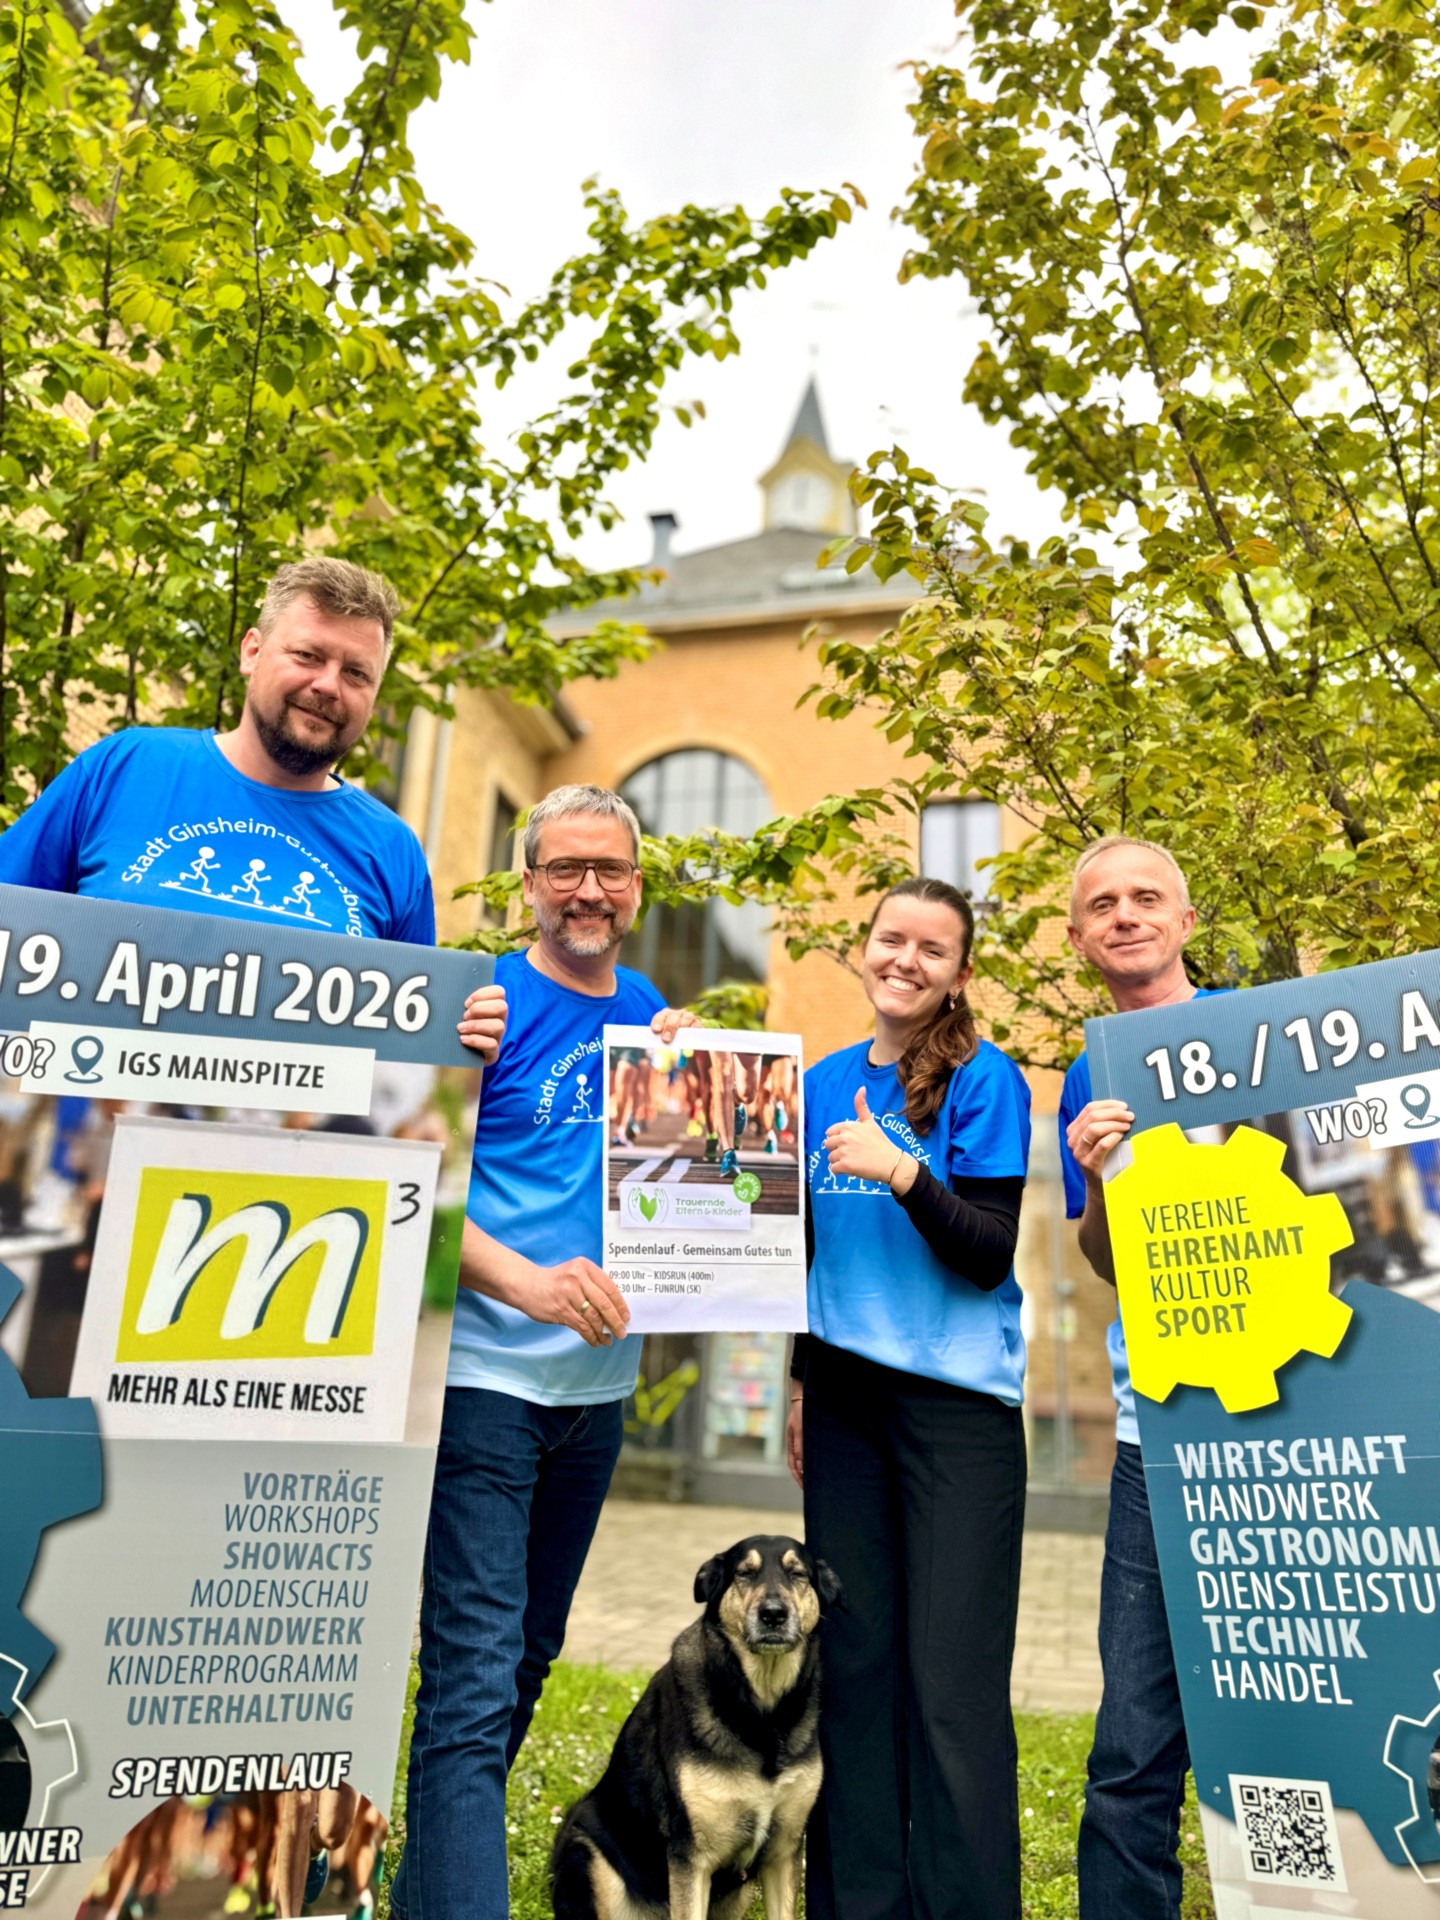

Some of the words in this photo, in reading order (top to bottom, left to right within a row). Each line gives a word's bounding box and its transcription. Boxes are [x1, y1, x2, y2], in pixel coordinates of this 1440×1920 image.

[121, 836, 172, 884] Stadt
[95, 941, 262, 1025] April
[273, 961, 430, 1033] 2026
[0, 1034, 56, 1079] O?
[1145, 1040, 1238, 1101] 18.
[1284, 1009, 1387, 1073] 19.
[1401, 990, 1440, 1053] A
[118, 1050, 162, 1077] IGS
[167, 1054, 325, 1089] MAINSPITZE
[533, 1078, 560, 1125] Stadt
[551, 1036, 604, 1077] Ginshei
[1306, 1097, 1388, 1145] WO?
[675, 1198, 726, 1207] Trauernde
[1141, 1195, 1251, 1234] VEREINE
[608, 1242, 676, 1257] Spendenlauf
[683, 1243, 742, 1257] Gemeinsam
[744, 1244, 773, 1257] Gutes
[774, 1246, 792, 1257] tun
[1145, 1225, 1304, 1270] EHRENAMT
[609, 1270, 631, 1280] 09:00
[631, 1270, 645, 1280] Uhr
[654, 1271, 687, 1280] KIDSRUN
[688, 1271, 714, 1282] (400m)
[632, 1284, 646, 1293] Uhr
[654, 1284, 685, 1293] FUNRUN
[686, 1284, 702, 1295] (5K)
[1150, 1266, 1252, 1303] KULTUR
[1155, 1302, 1247, 1338] SPORT
[107, 1373, 178, 1405] MEHR
[183, 1378, 229, 1407] ALS
[233, 1380, 286, 1410] EINE
[290, 1383, 367, 1413] MESSE
[1173, 1435, 1407, 1479] WIRTSCHAFT
[243, 1468, 384, 1503] VORTRÄGE
[1182, 1481, 1380, 1522] HANDWERK
[224, 1503, 380, 1535] WORKSHOPS
[223, 1541, 373, 1571] SHOWACTS
[190, 1578, 369, 1608] MODENSCHAU
[1196, 1571, 1440, 1614] DIENSTLEISTU
[104, 1616, 366, 1646] KUNSTHANDWERK
[1201, 1615, 1368, 1658] TECHNIK
[107, 1653, 359, 1685] KINDERPROGRAMM
[1211, 1659, 1354, 1705] HANDEL
[126, 1692, 354, 1725] UNTERHALTUNG
[109, 1751, 351, 1797] SPENDENLAUF
